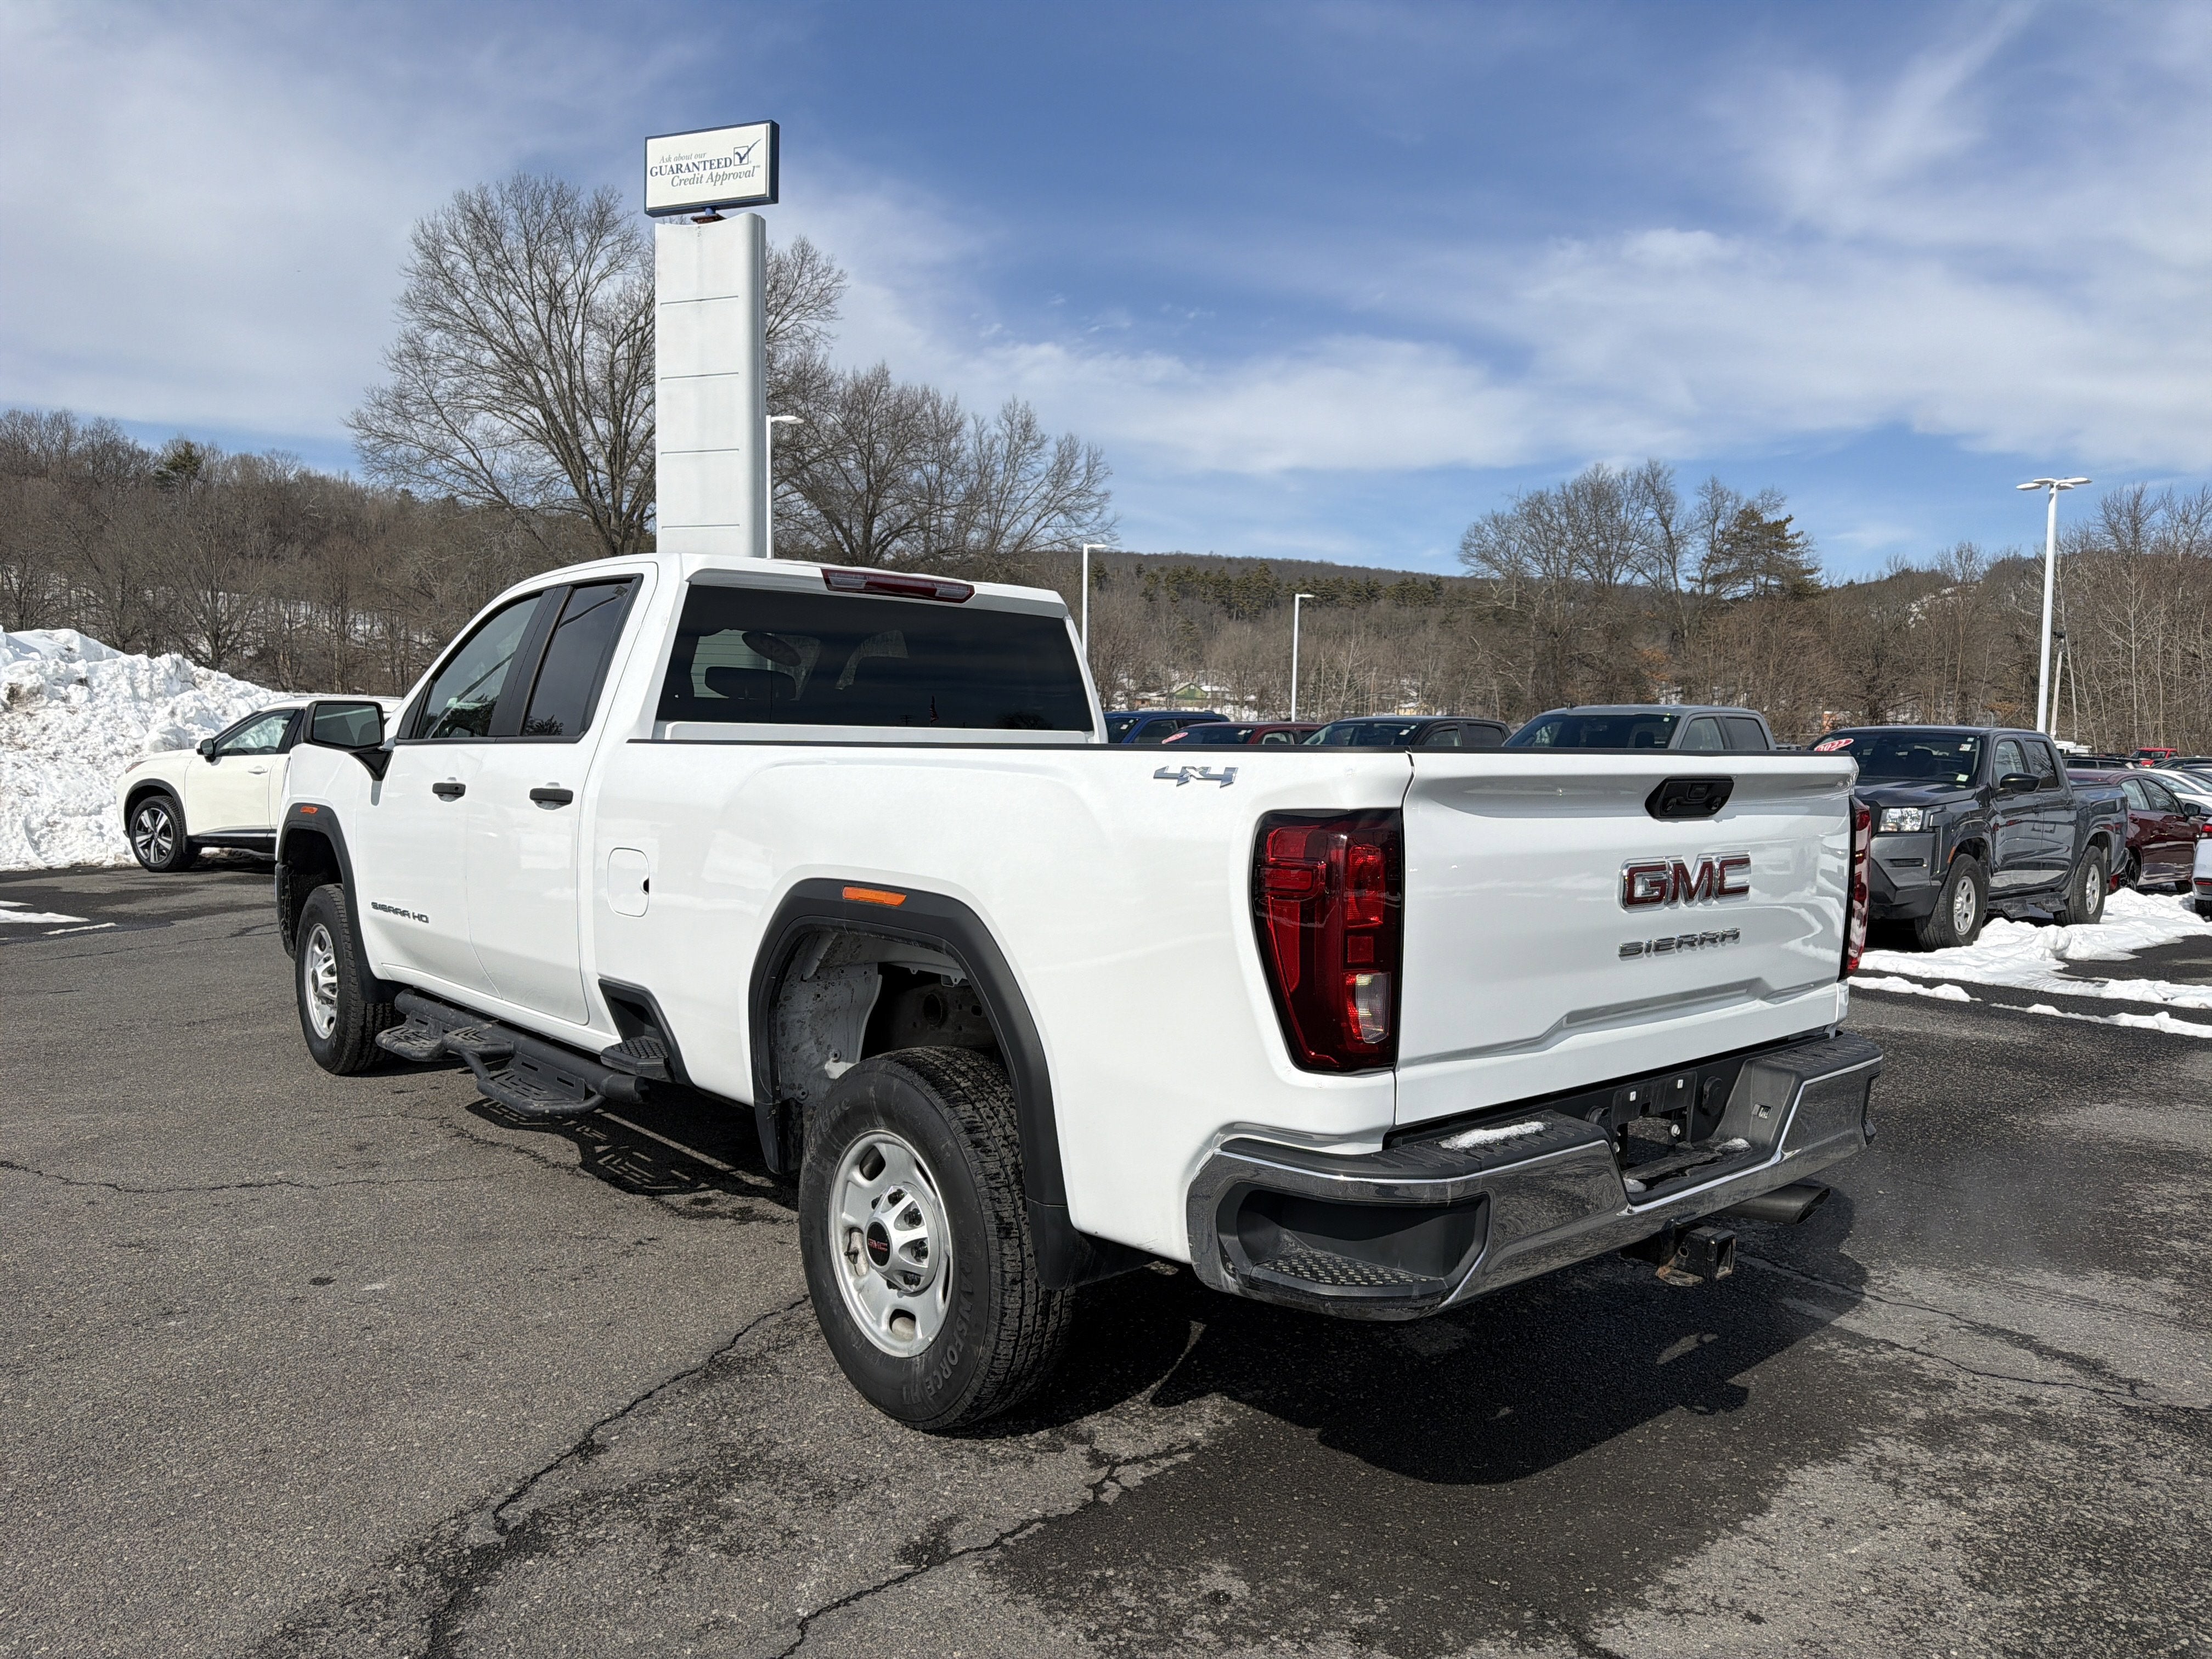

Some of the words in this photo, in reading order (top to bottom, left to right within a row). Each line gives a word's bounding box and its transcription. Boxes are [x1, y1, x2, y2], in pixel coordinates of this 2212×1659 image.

[650, 156, 732, 177] GUARANTEED
[674, 153, 692, 161] about
[671, 173, 703, 187] Credit
[706, 165, 755, 186] Approval
[1618, 850, 1751, 913] GMC
[371, 902, 411, 919] SIERRA
[413, 912, 429, 923] HD
[1618, 927, 1741, 960] SIERRA
[868, 1238, 888, 1251] GMC
